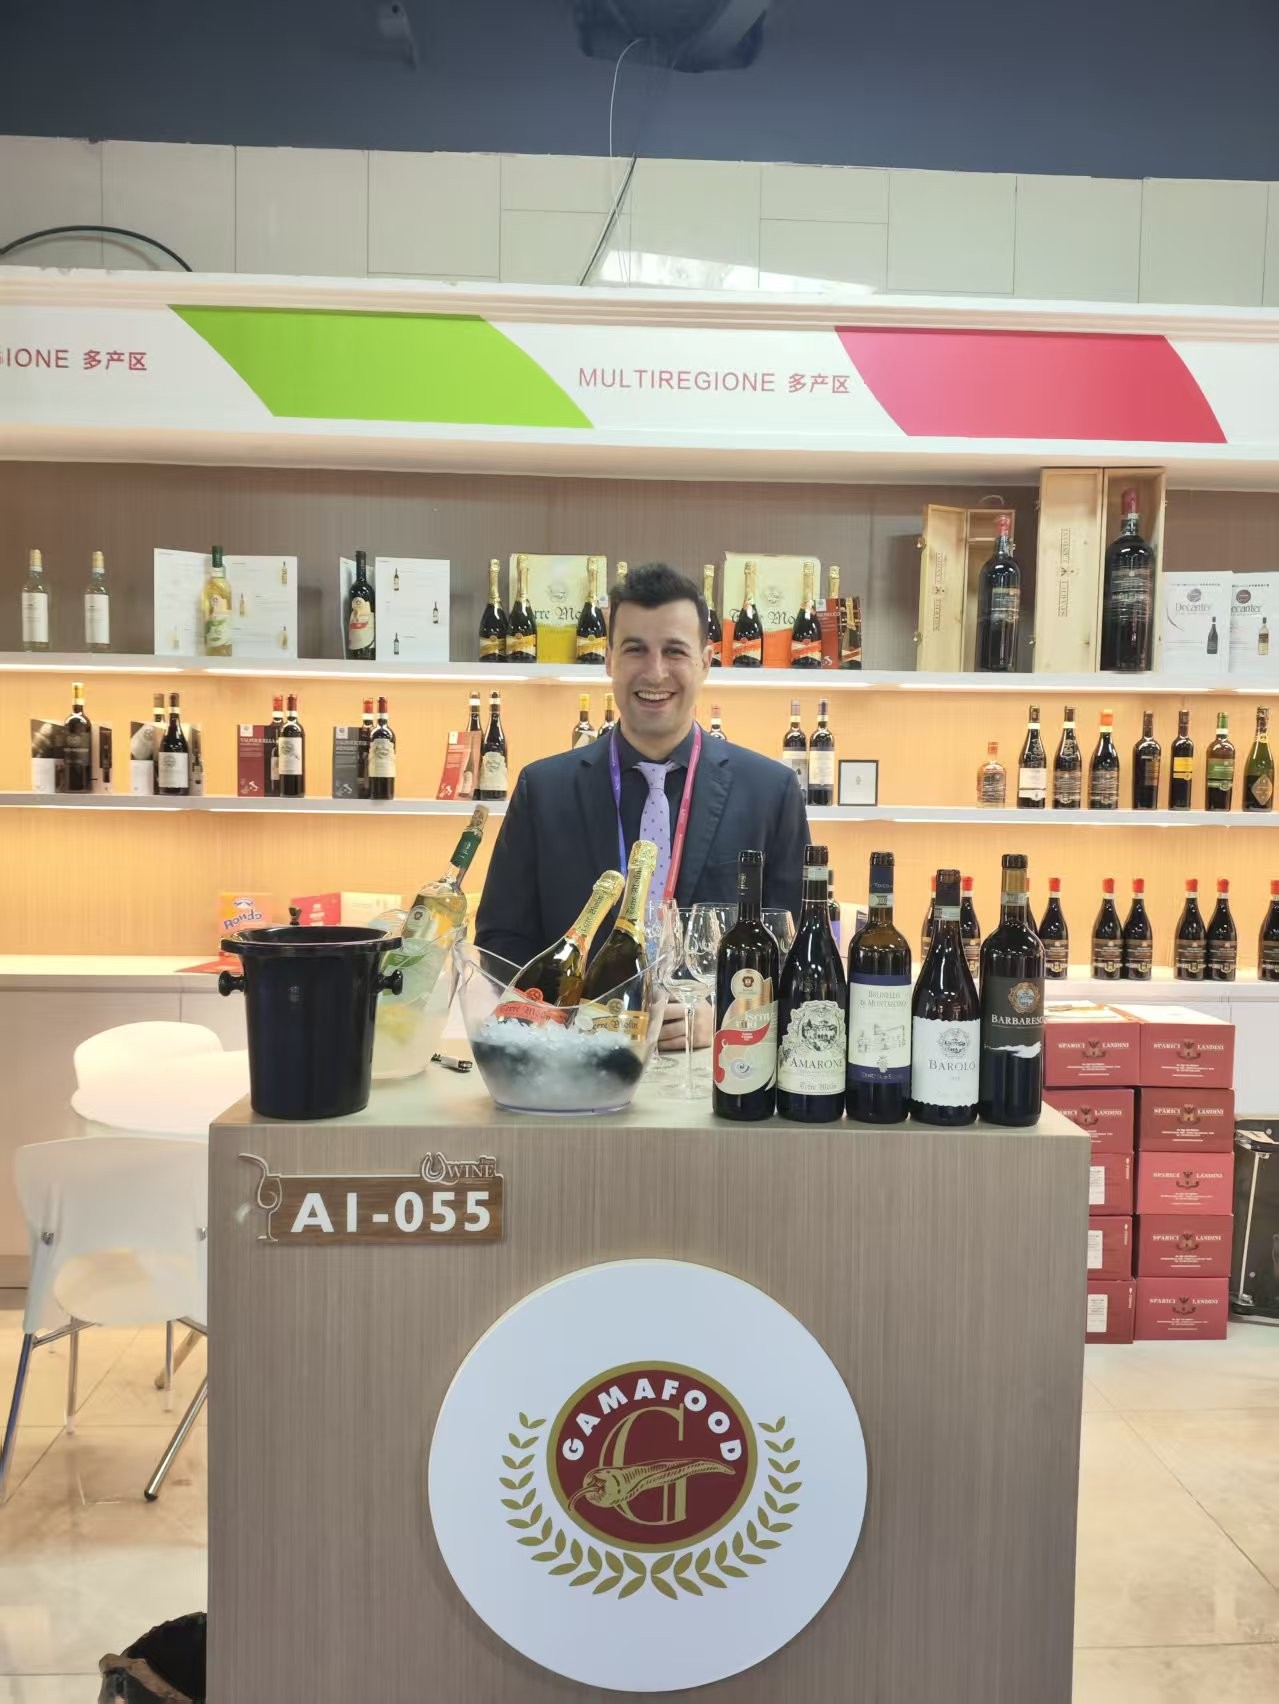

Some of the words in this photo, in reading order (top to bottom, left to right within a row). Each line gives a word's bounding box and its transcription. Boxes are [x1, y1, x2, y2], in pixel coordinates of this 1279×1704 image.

[0, 348, 69, 368] IONE
[83, 350, 147, 371] 多产区
[578, 367, 775, 392] MULTIREGIONE
[788, 373, 850, 394] 多产区
[1231, 604, 1263, 613] ecanter
[929, 1059, 976, 1070] BAROLO
[562, 1378, 742, 1461] GAMAFOOD
